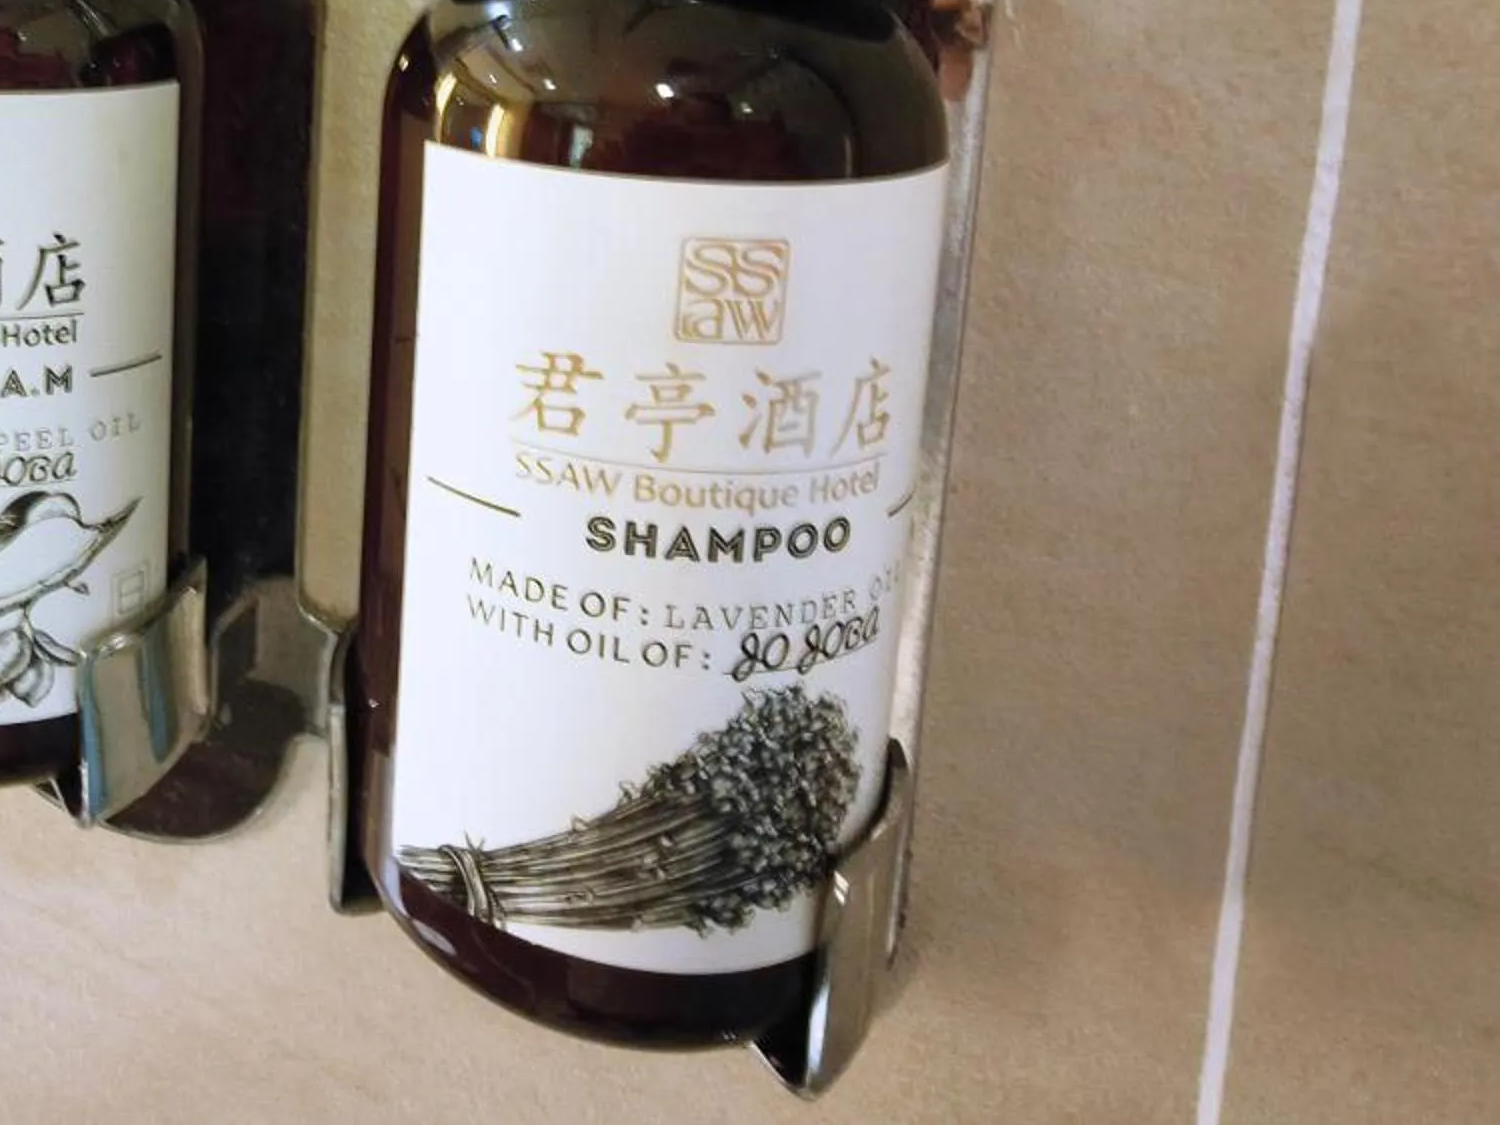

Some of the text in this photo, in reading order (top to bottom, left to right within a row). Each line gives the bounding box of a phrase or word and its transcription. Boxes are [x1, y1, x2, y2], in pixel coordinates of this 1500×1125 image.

[683, 241, 784, 299] SS
[0, 318, 79, 349] Hotel
[0, 364, 74, 399] A.M
[510, 350, 893, 465] 君亭酒店
[89, 410, 142, 443] OIL
[514, 450, 882, 517] SSAW Boutique Hotel
[584, 514, 852, 563] SHAMPOO
[468, 556, 569, 613] MADE
[579, 590, 651, 627] OF:
[662, 588, 857, 634] LAVENDER
[466, 591, 555, 650] WITH
[565, 626, 630, 666] OIL
[641, 640, 712, 673] OF:
